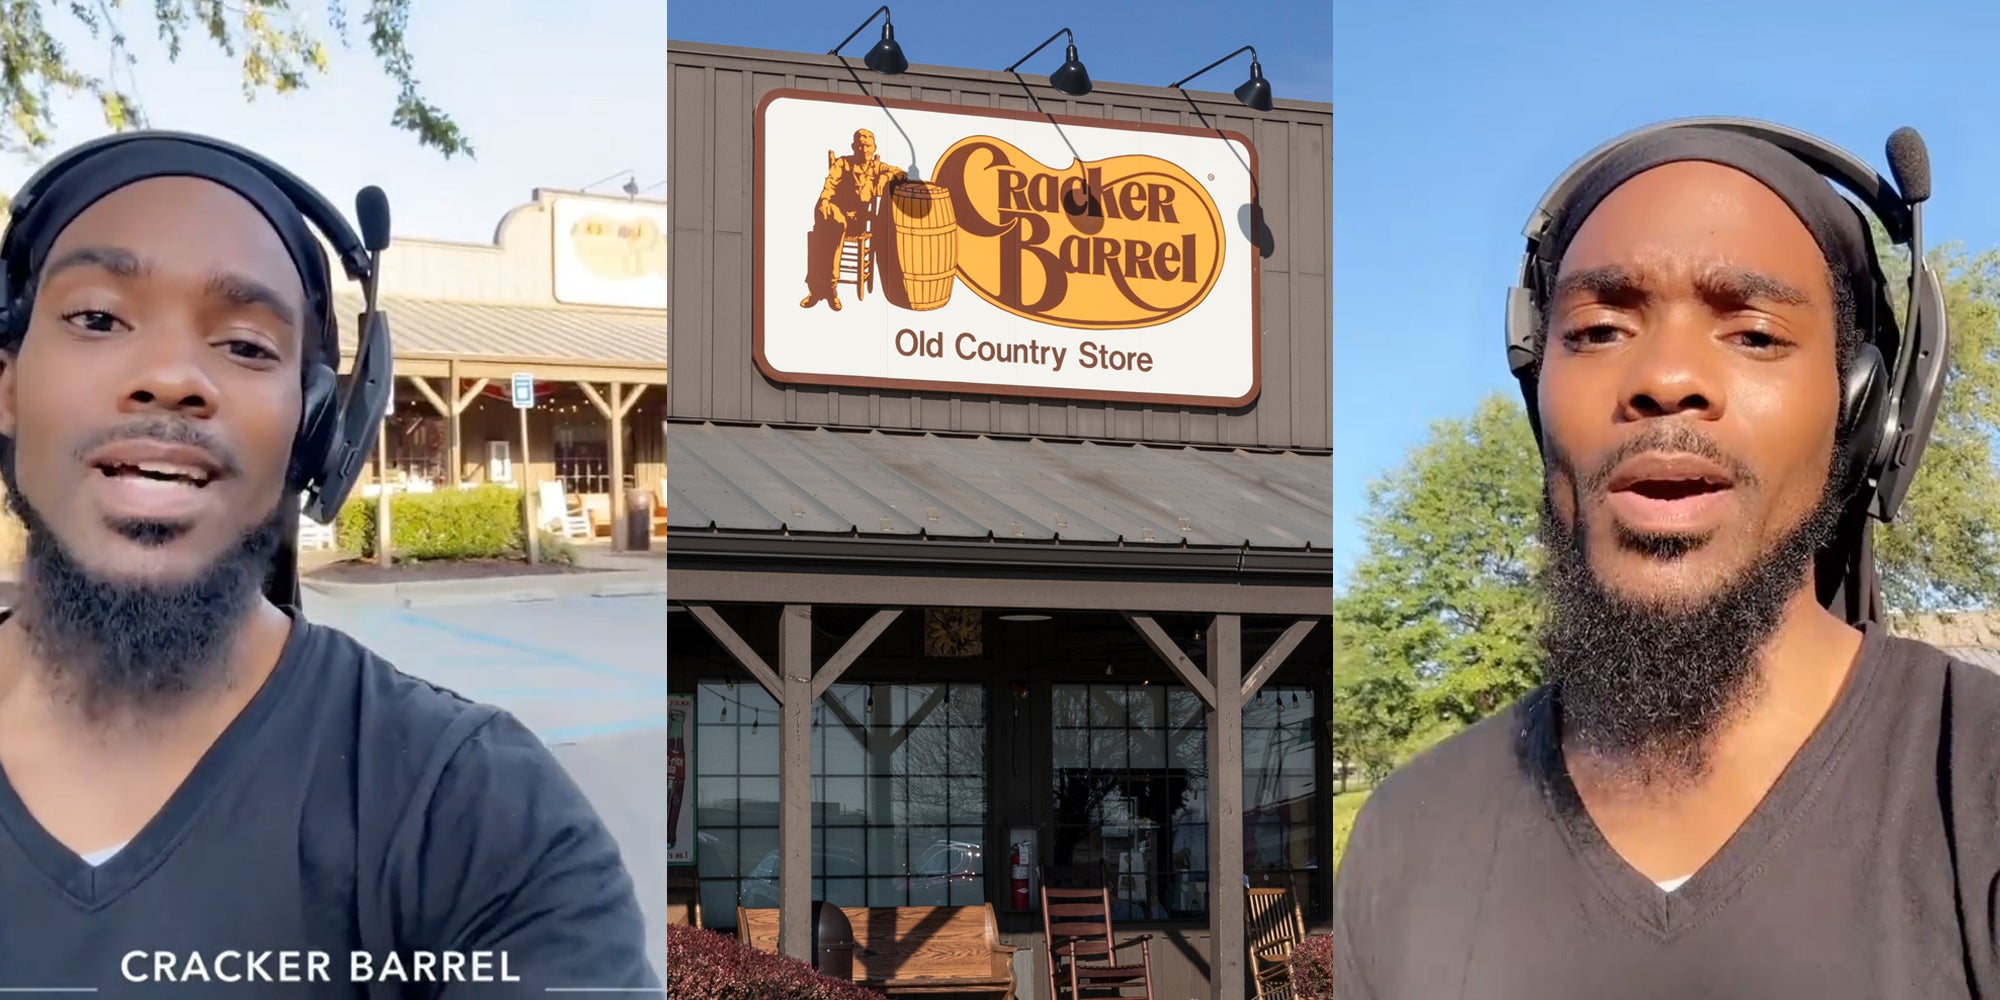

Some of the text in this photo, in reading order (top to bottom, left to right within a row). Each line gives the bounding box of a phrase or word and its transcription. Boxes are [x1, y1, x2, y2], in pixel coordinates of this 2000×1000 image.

[1000, 211, 1198, 312] Barrel
[895, 328, 1154, 373] Old Country Store
